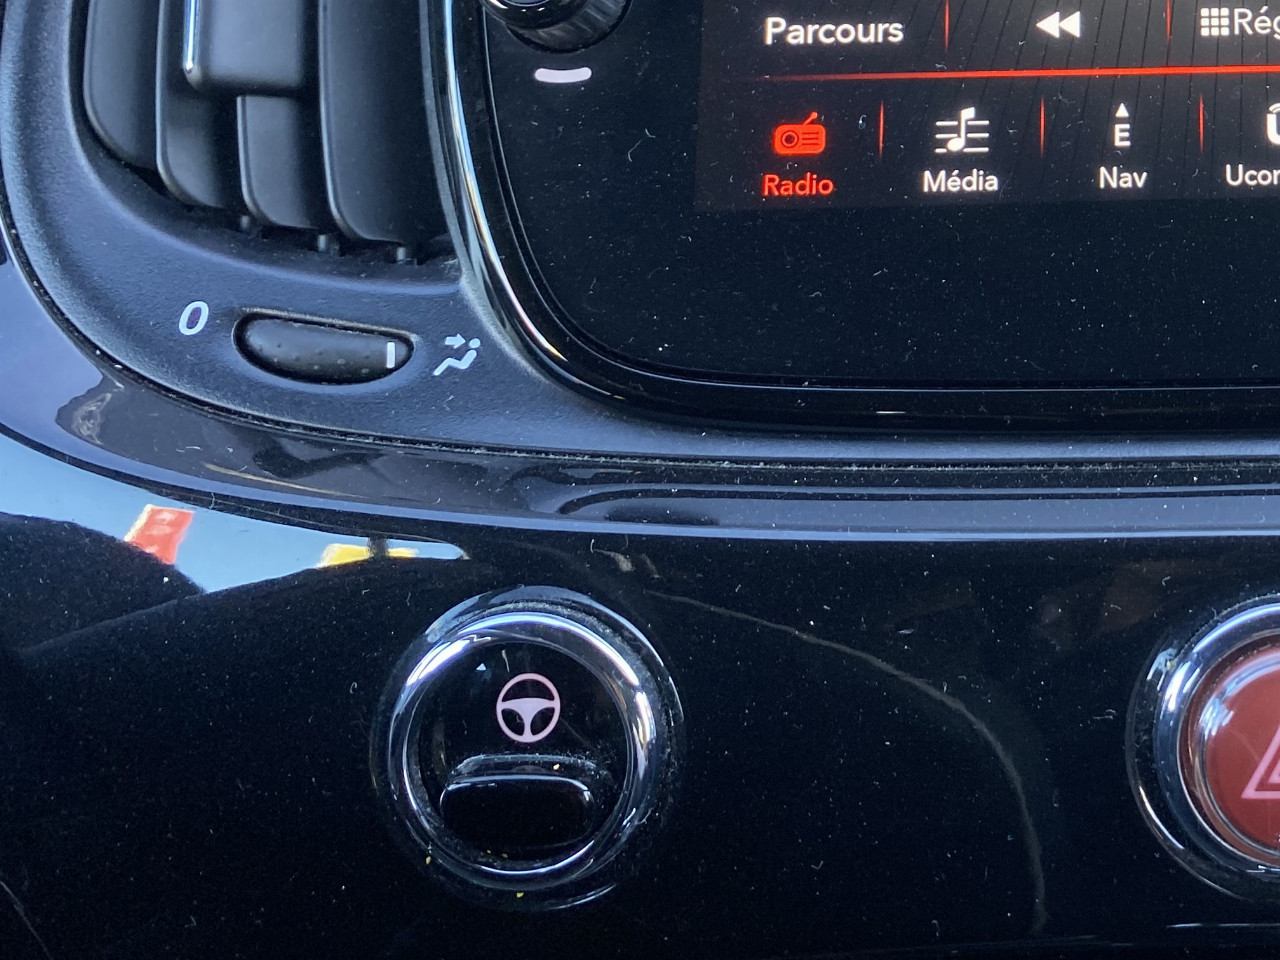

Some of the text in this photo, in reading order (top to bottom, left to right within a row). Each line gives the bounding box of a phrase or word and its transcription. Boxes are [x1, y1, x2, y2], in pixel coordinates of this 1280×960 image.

[764, 17, 904, 45] Parcours
[762, 174, 834, 196] Radio
[922, 167, 998, 193] Média
[1098, 167, 1148, 188] Nav
